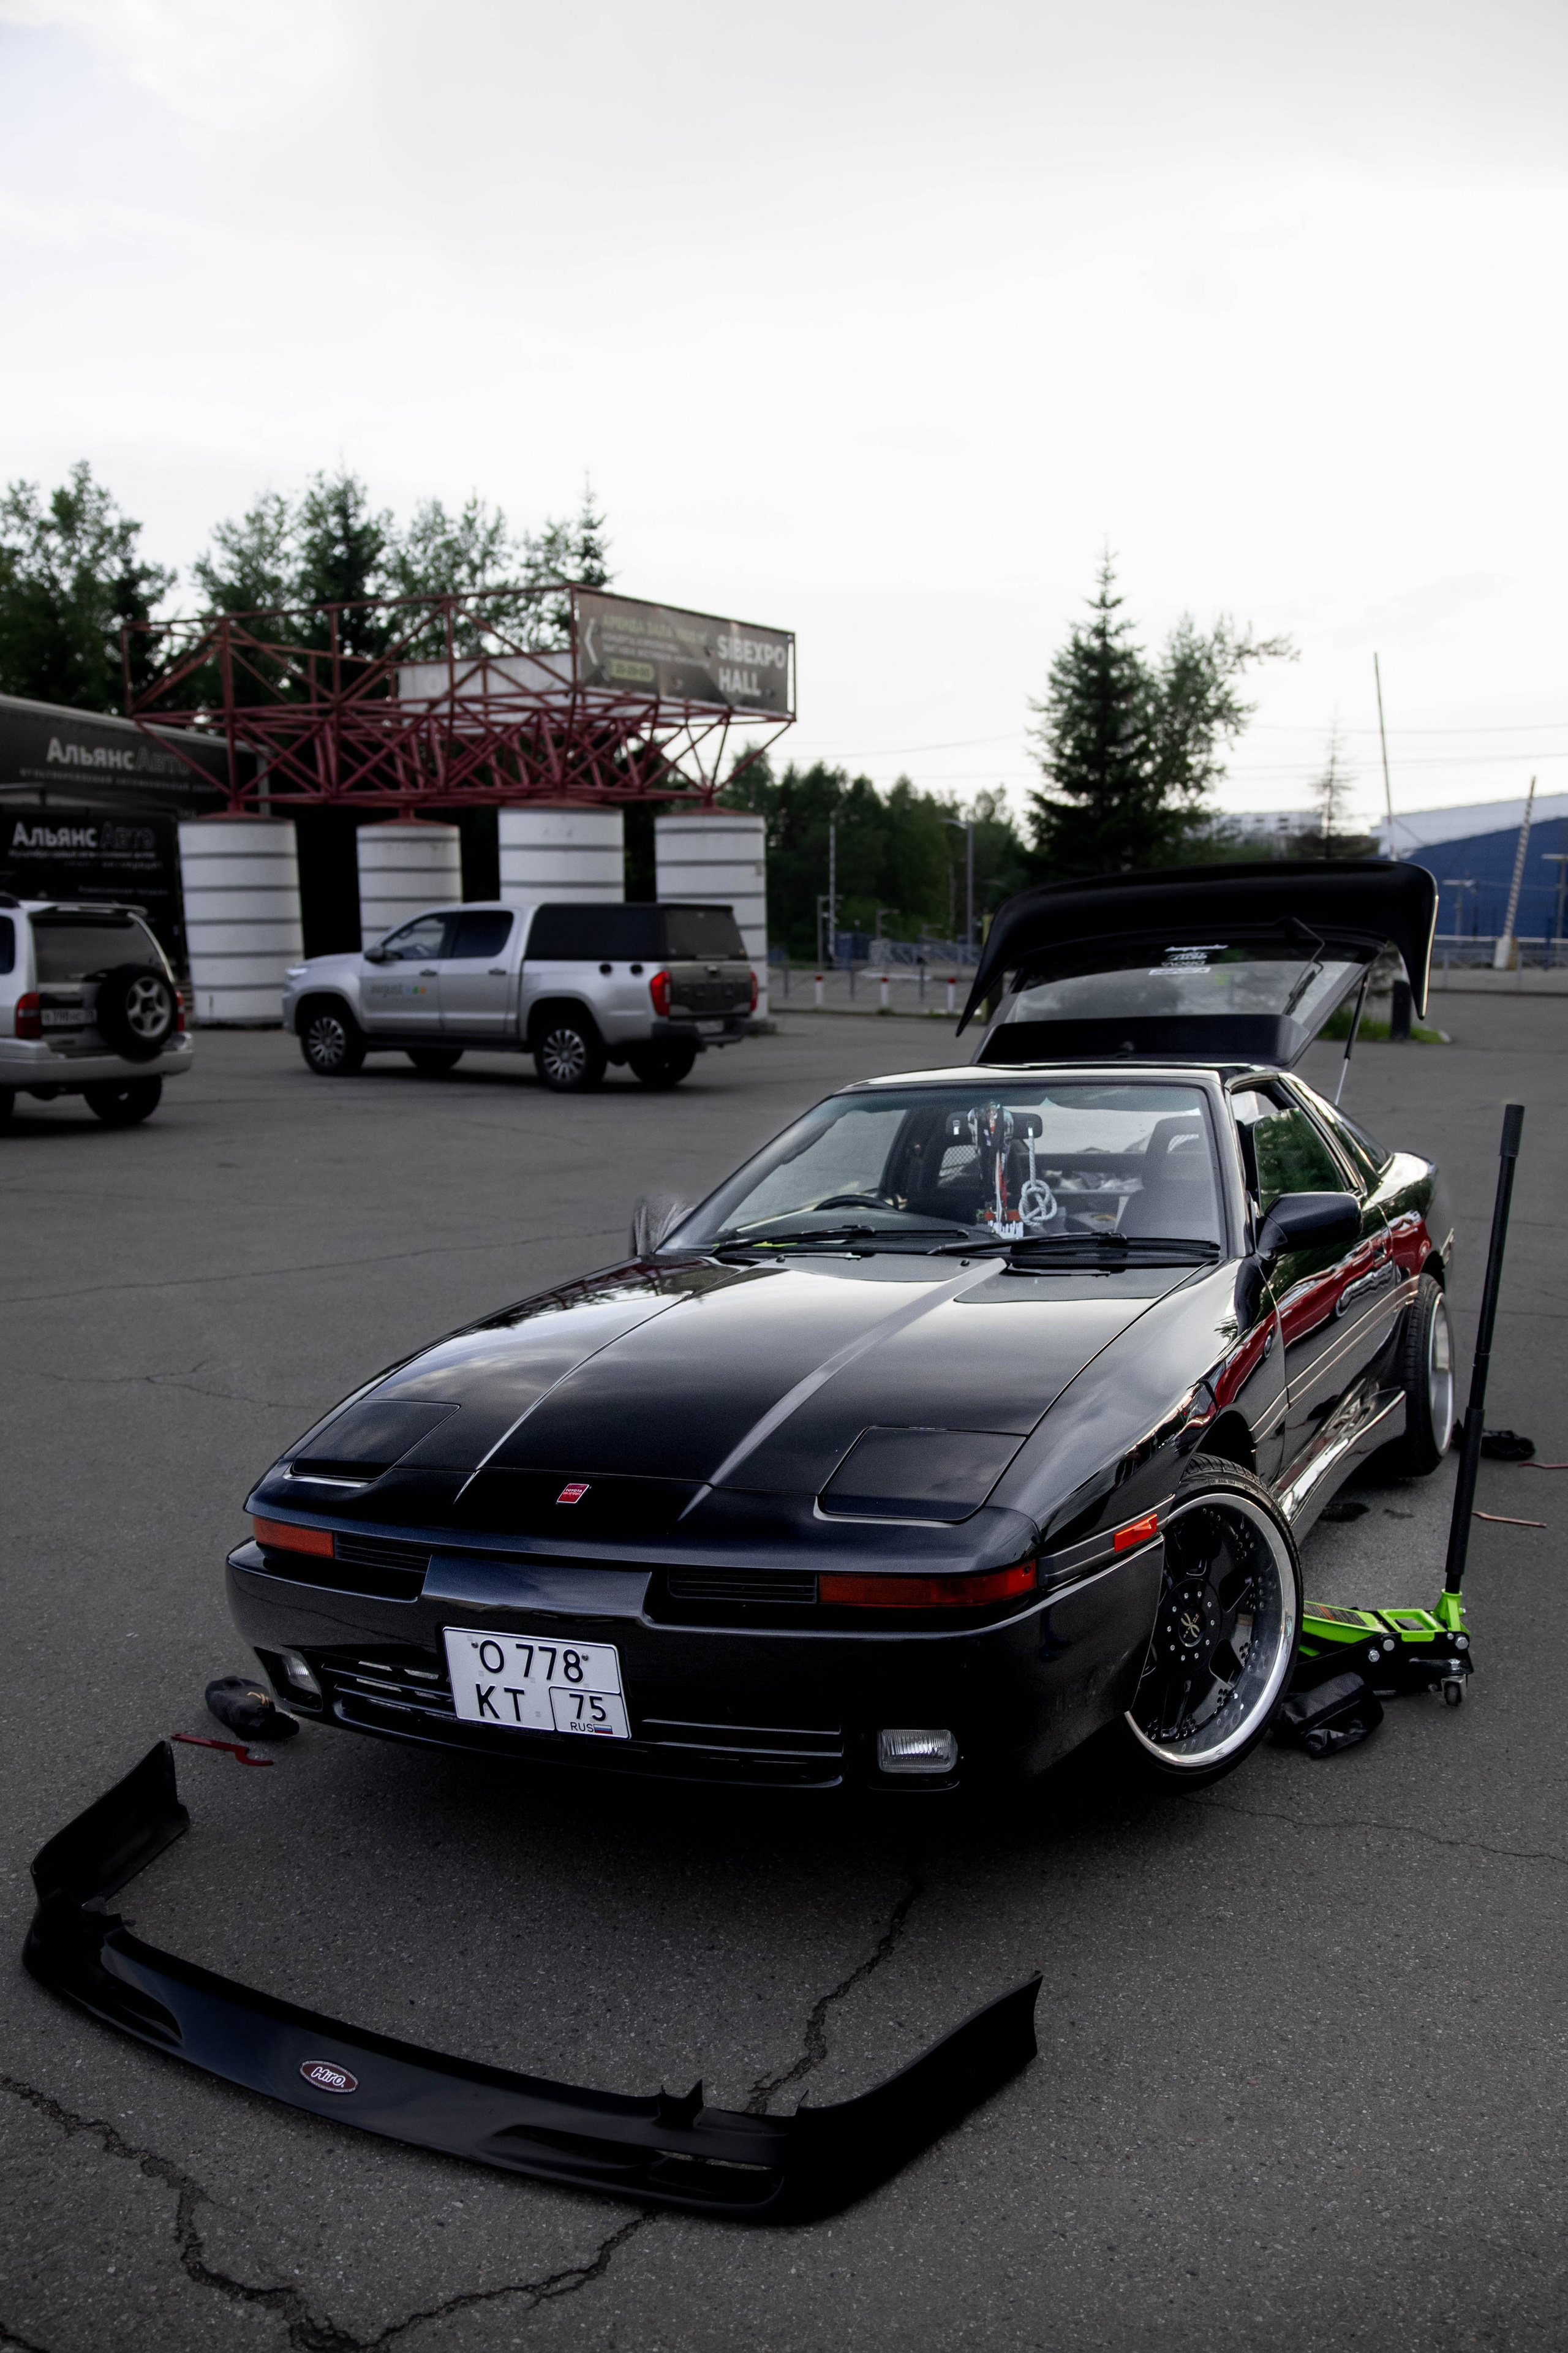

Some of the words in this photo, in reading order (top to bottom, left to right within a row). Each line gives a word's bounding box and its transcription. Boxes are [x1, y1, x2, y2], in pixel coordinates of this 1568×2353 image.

[717, 634, 786, 670] SIBEXPO
[718, 667, 761, 697] HALL
[47, 736, 134, 770] Альянс
[12, 821, 98, 848] Альянс
[515, 1642, 583, 1683] 778
[569, 1693, 606, 1721] 75
[570, 1721, 594, 1733] RUS
[311, 2066, 346, 2086] Hiro
